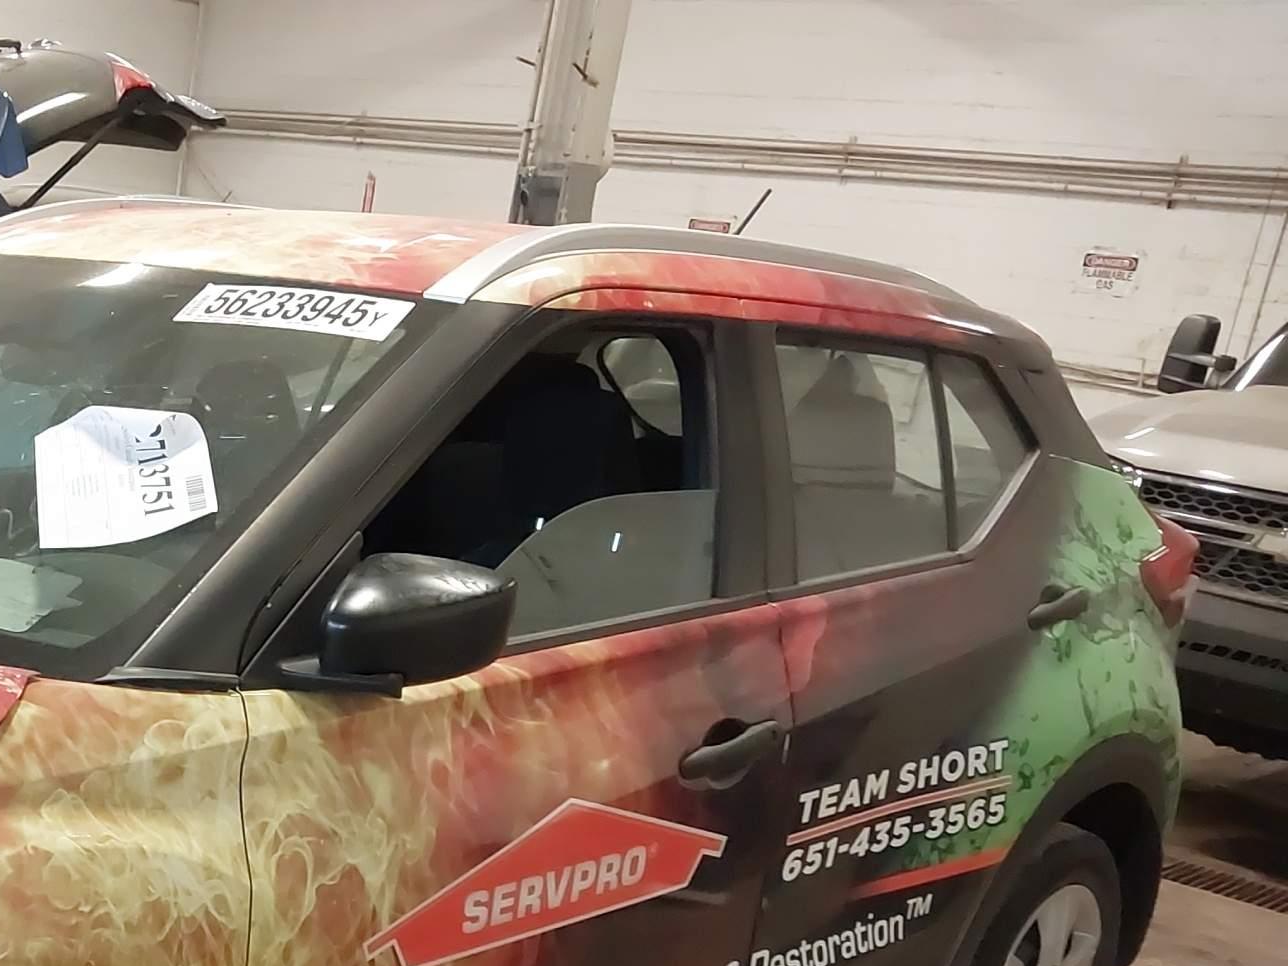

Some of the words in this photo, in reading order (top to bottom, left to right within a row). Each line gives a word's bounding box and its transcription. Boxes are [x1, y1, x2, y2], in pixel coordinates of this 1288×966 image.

[798, 768, 891, 825] TEAM
[896, 738, 1009, 795] SHORT
[781, 793, 1007, 883] 651-435-3565
[461, 845, 647, 935] SERVPRO
